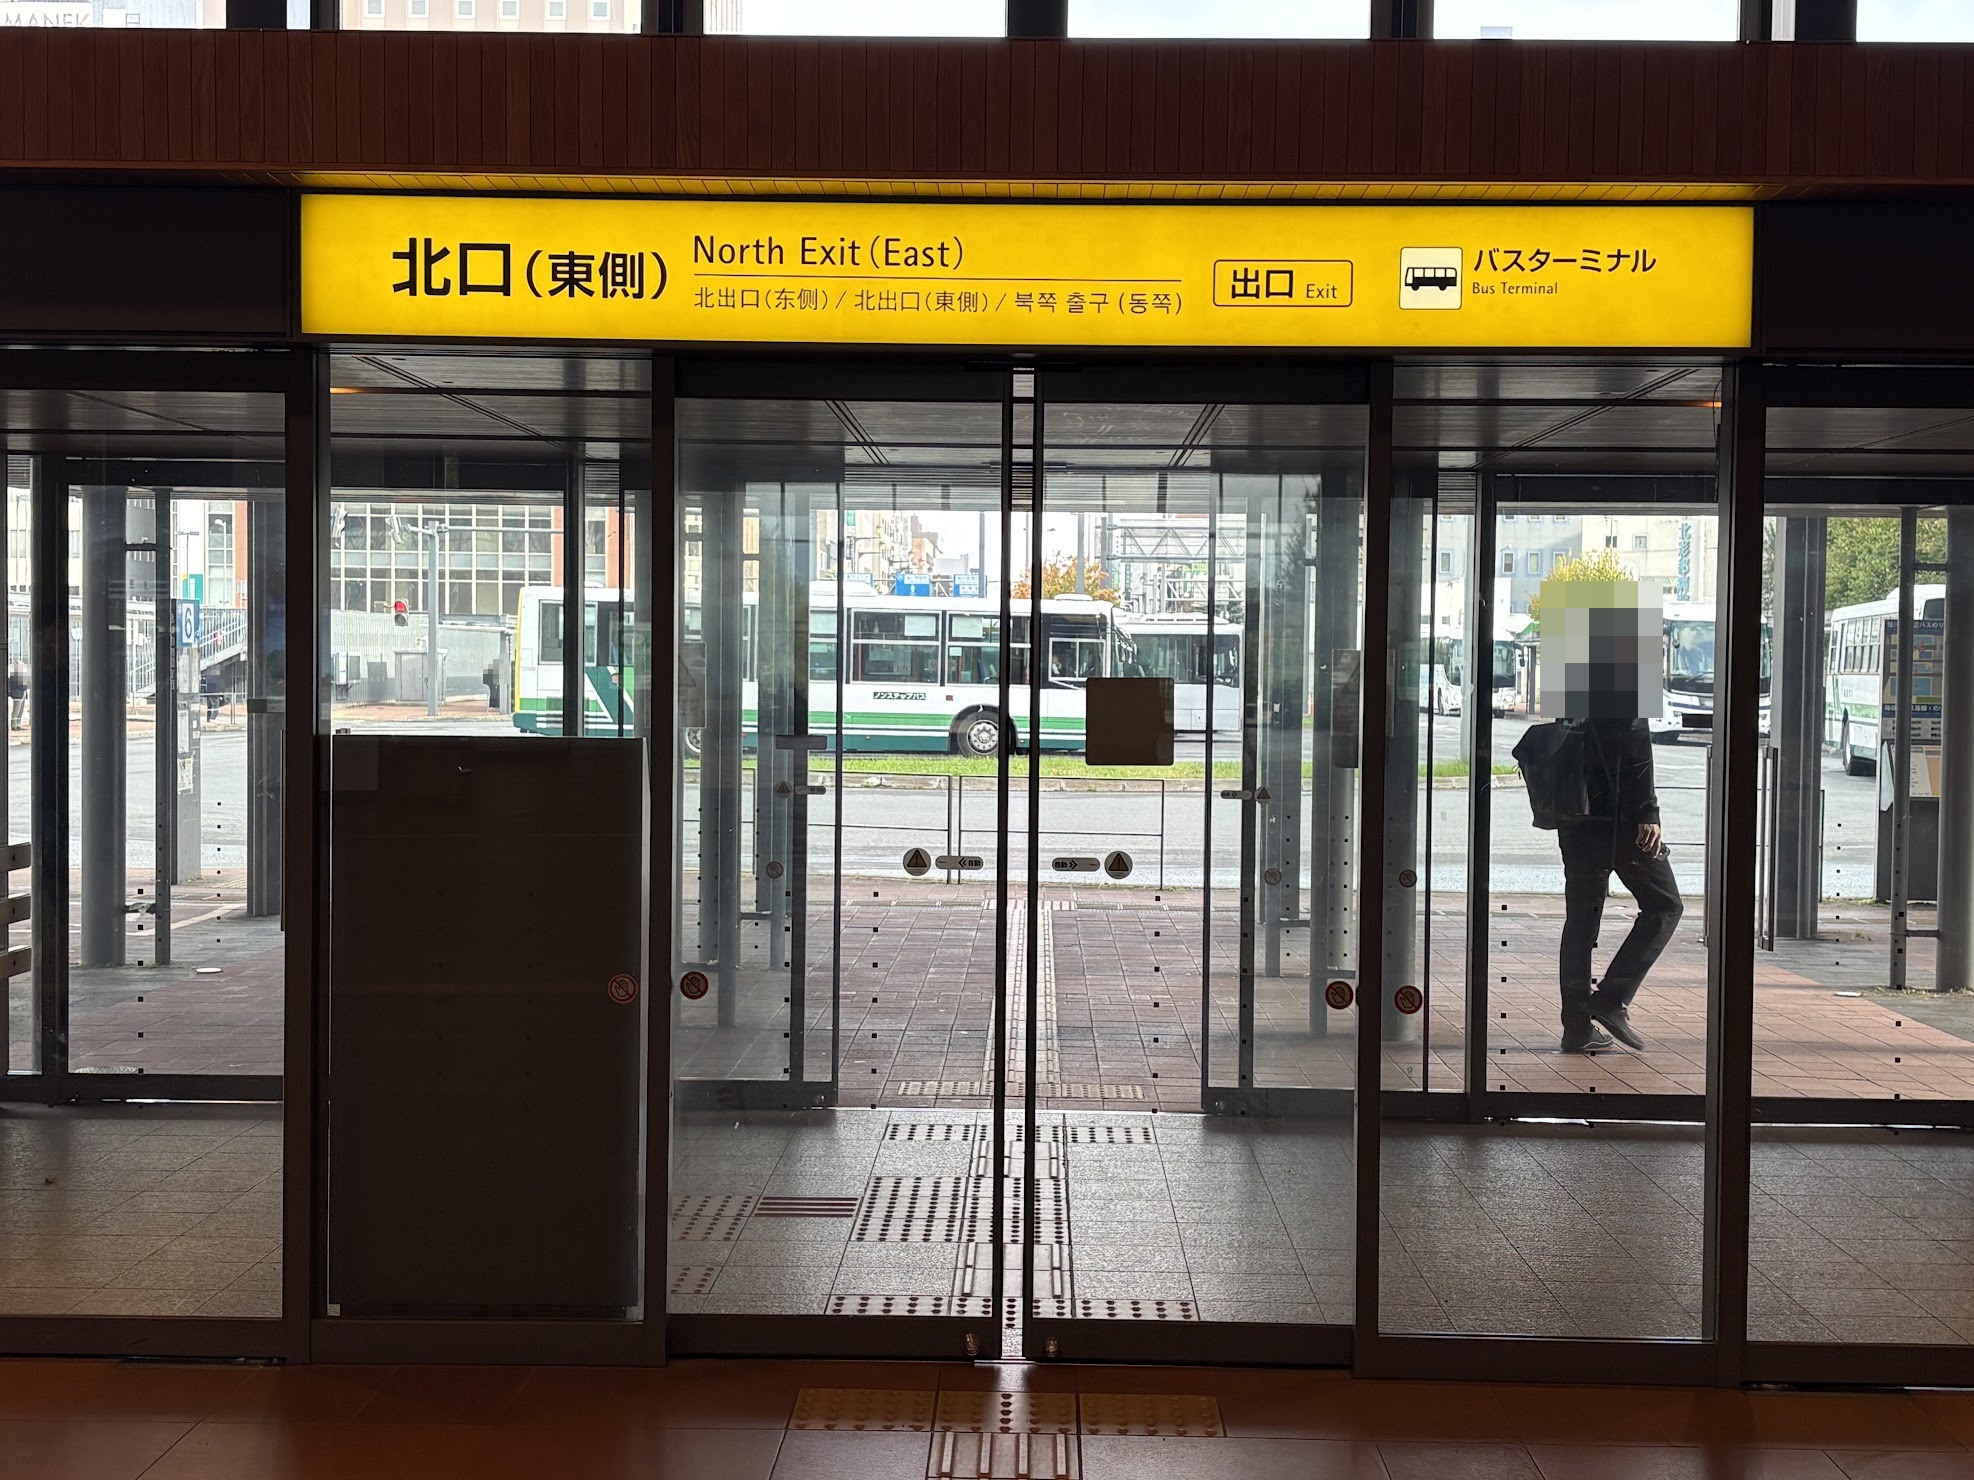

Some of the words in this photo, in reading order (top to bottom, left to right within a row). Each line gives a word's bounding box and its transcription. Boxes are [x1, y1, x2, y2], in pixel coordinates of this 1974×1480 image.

[693, 235, 784, 265] North
[1473, 247, 1657, 274] バスターミナル
[393, 237, 667, 300] 北口(東側)
[1231, 267, 1294, 301] 出口
[1306, 282, 1338, 300] Exit
[1472, 281, 1496, 296] Bus
[1500, 281, 1558, 297] Terminal
[1014, 292, 1057, 313] 북쪽
[1066, 292, 1109, 314] 출구
[184, 606, 193, 639] 6
[874, 691, 926, 701] ノンステップバス
